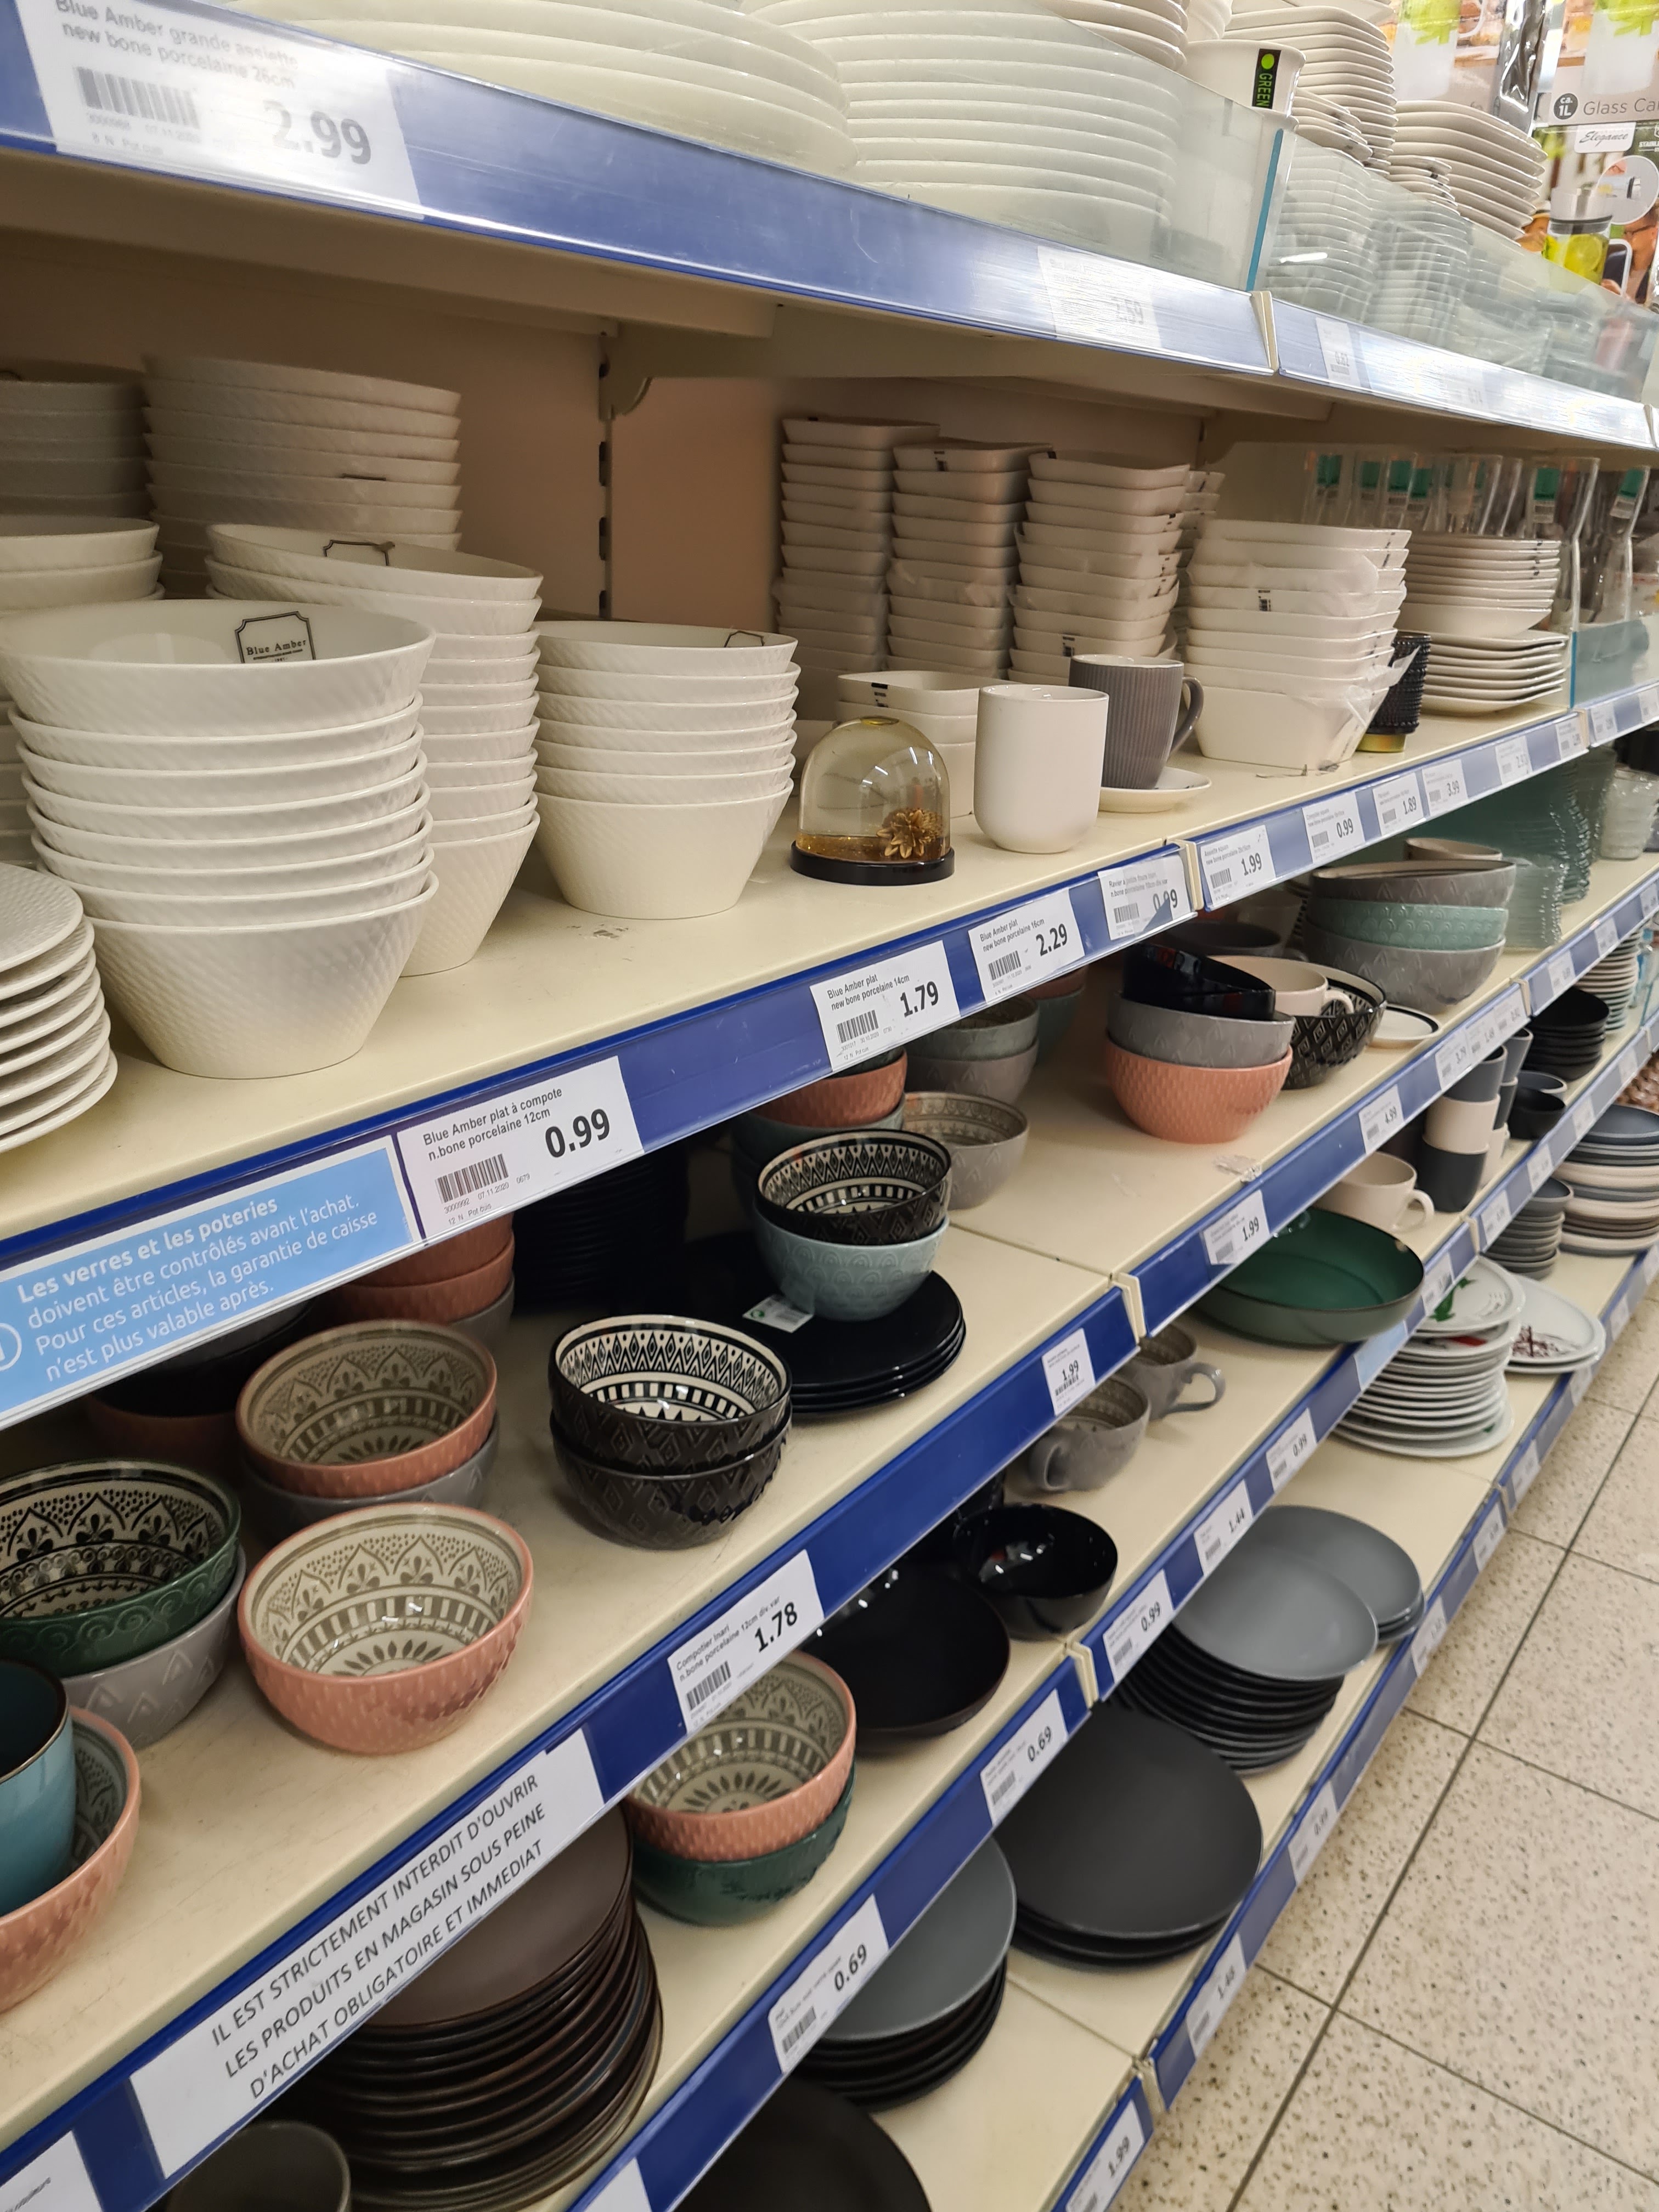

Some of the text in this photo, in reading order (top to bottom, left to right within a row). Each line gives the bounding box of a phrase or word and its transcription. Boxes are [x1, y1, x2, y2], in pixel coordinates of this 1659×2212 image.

[105, 7, 163, 36] Amber
[170, 27, 230, 52] grande
[62, 23, 100, 43] new
[105, 31, 151, 56] bone
[157, 47, 247, 78] porcelaine
[1256, 73, 1272, 106] GREEN
[1583, 101, 1628, 115] Glass
[1559, 105, 1571, 116] 1L
[264, 99, 371, 165] 2.99
[1579, 131, 1629, 148] Elegance
[246, 646, 269, 656] Blue
[274, 640, 306, 652] Amber
[1403, 796, 1417, 815] 1.89
[1447, 780, 1460, 797] 3.99
[1336, 818, 1354, 838] 0.99
[1241, 853, 1262, 876] 1.99
[980, 919, 1018, 942] Blue Amber plat
[983, 918, 1045, 952] new bone porcelaine 16cm
[1036, 923, 1068, 957] 2.29
[827, 973, 878, 1000] Blue Amber plat
[831, 974, 910, 1011] new bone porcelaine 14cm
[900, 981, 939, 1018] 1.79
[422, 1087, 563, 1147] Blue Amber plat à compote
[428, 1107, 551, 1161] n.bone porcelaine 12cm
[545, 1108, 610, 1159] 0.99
[1242, 1216, 1260, 1242] 1.99
[17, 1197, 278, 1305] Les verres et les poteries
[27, 1193, 360, 1329] doivent être contrôlés avant l'achat.
[35, 1210, 379, 1356] Pour ces articles, la garantie de caisse
[45, 1278, 275, 1382] n'est plus valable après.
[1062, 1359, 1079, 1381] 1.99
[754, 1601, 798, 1653] 1.78
[676, 1637, 713, 1671] Compotier
[713, 1623, 730, 1641] Inari
[680, 1658, 704, 1682] n.bone
[705, 1629, 740, 1663] porcelaine
[741, 1615, 759, 1631] 12cm
[1028, 1725, 1052, 1763] 0.69
[211, 1774, 540, 2048] IL EST STRICTEMENT INTERDIT D'OUVRIR
[225, 1803, 547, 2079] LES PRODUITS EN MAGASIN SOUS PEINE
[250, 1838, 545, 2100] D'ACHAT OBLIGATOIRE ET IMMEDIAT
[834, 1944, 867, 1992] 0.69
